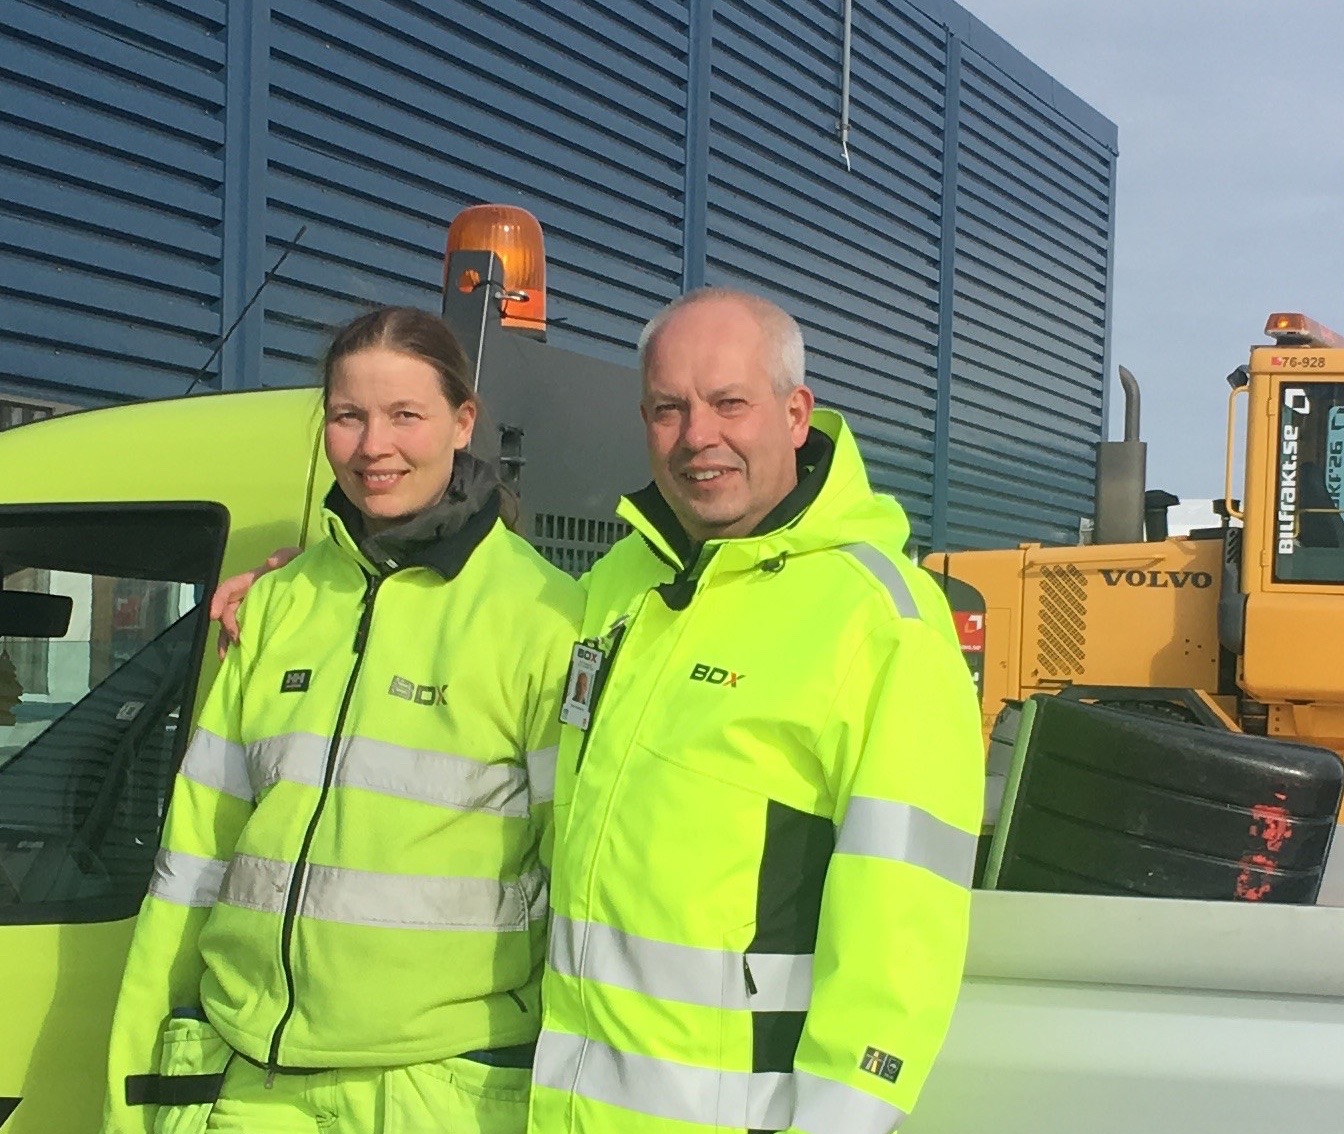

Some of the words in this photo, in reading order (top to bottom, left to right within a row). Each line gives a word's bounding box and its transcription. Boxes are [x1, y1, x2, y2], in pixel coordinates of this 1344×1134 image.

[1097, 569, 1213, 588] VOLVO
[689, 663, 746, 688] BDX
[388, 675, 449, 706] BDX
